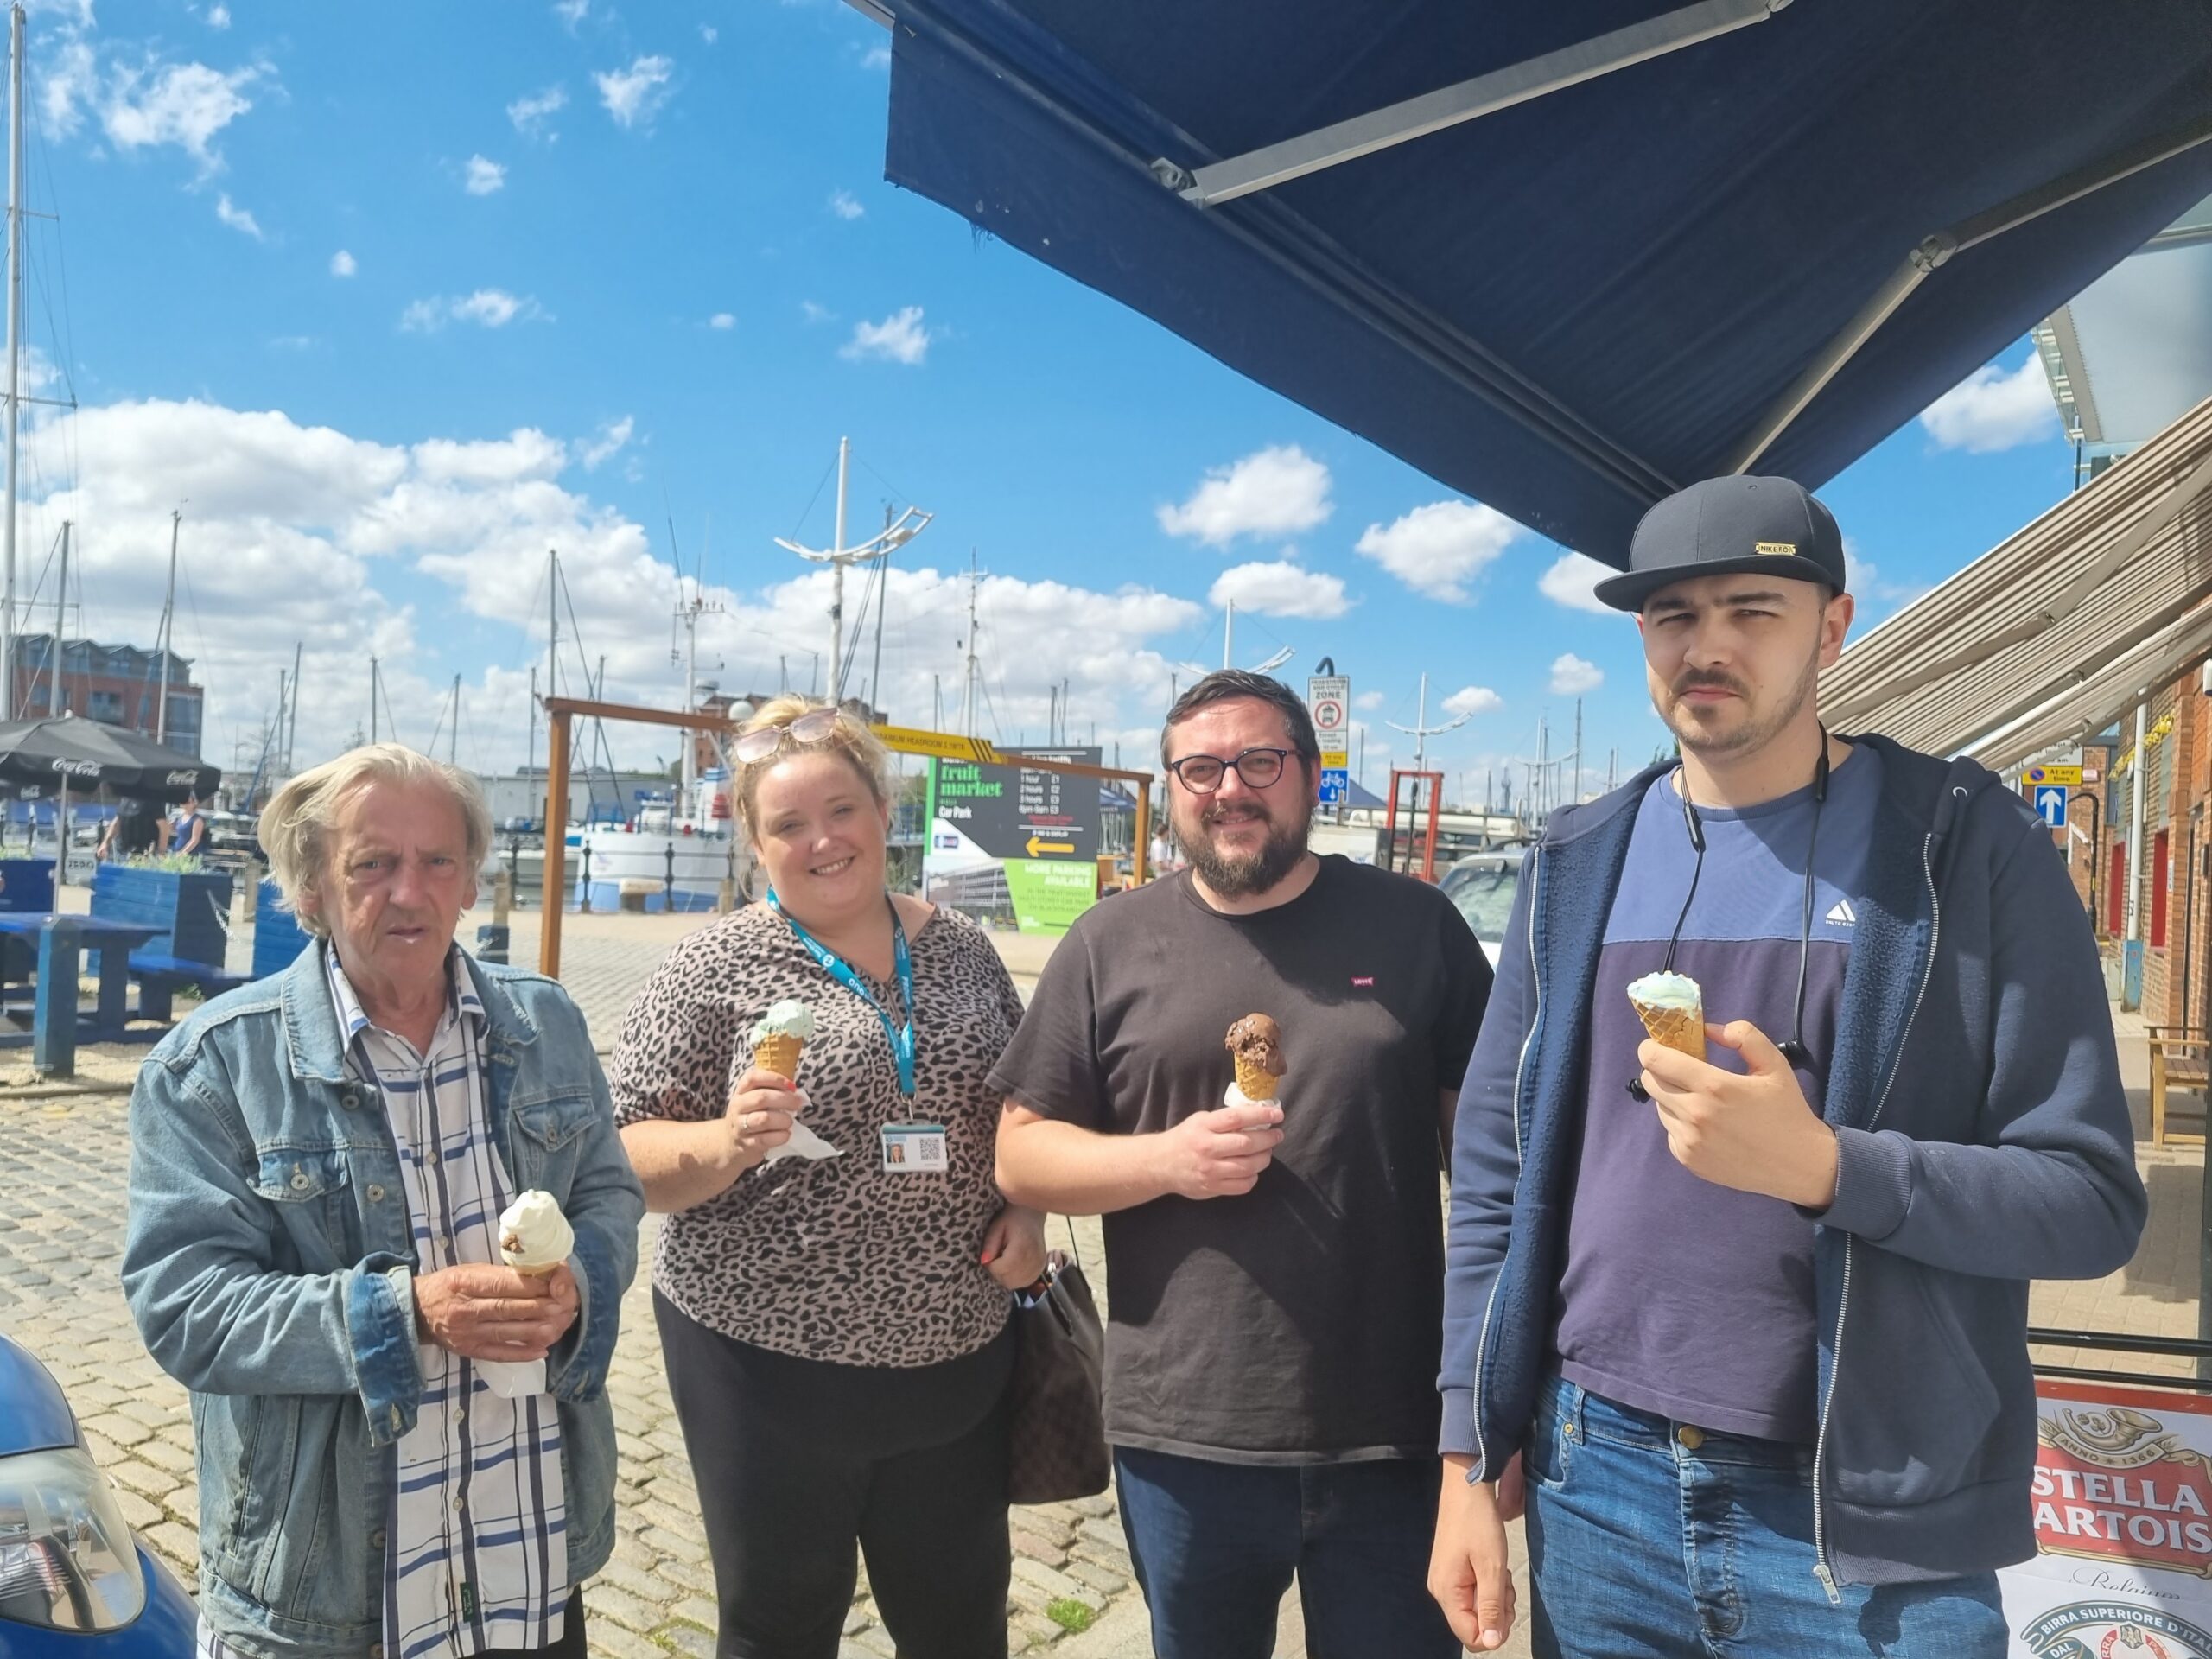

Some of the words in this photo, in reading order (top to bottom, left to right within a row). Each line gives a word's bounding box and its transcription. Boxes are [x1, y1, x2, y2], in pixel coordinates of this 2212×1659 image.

[941, 764, 982, 781] fruit
[940, 781, 1003, 797] market
[938, 805, 953, 818] Car
[953, 805, 972, 819] Park
[1052, 864, 1092, 876] PARKING
[1044, 875, 1091, 888] AVAILABLE
[2060, 1437, 2100, 1461] ANNO
[2122, 1449, 2156, 1466] 1366
[2031, 1466, 2209, 1516] STELLA
[2033, 1502, 2212, 1554] ARTOIS
[2040, 1611, 2079, 1636] BIRRA
[2079, 1608, 2163, 1629] SUPERIORE
[2050, 1642, 2074, 1659] DAL
